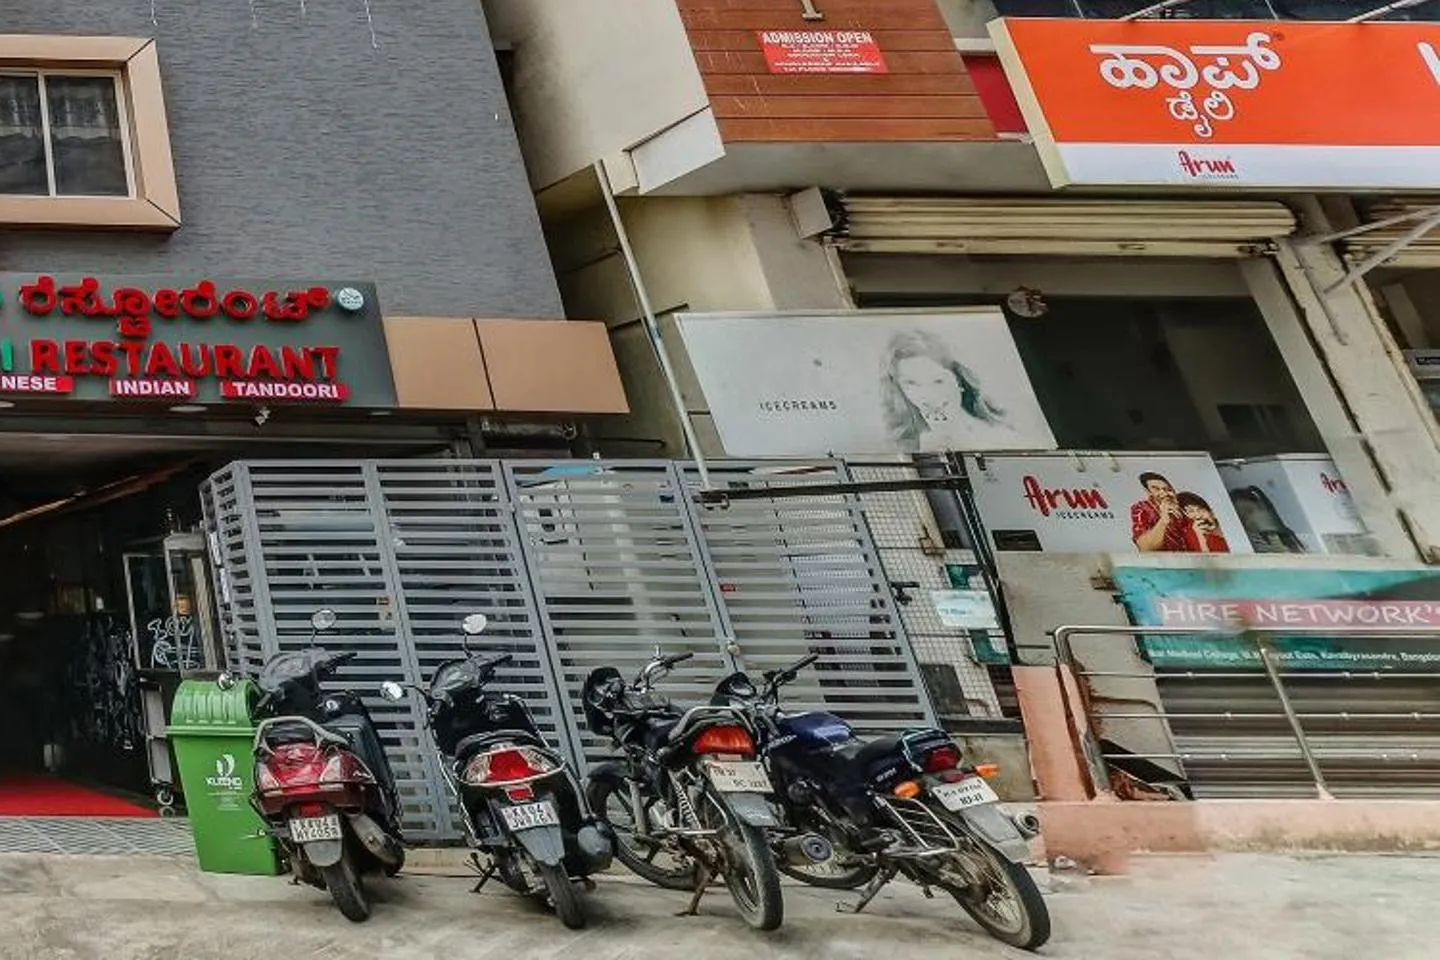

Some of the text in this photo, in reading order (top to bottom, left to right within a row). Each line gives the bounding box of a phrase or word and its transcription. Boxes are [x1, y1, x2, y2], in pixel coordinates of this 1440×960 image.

[763, 30, 873, 44] ADMISSION OPEN
[1178, 150, 1236, 178] Arun
[30, 339, 341, 381] RESTAURANT
[115, 380, 191, 397] INDIAN
[232, 382, 340, 400] TANDOORI
[1023, 475, 1109, 517] Arun
[1160, 603, 1440, 624] HIRE NETWORK'
